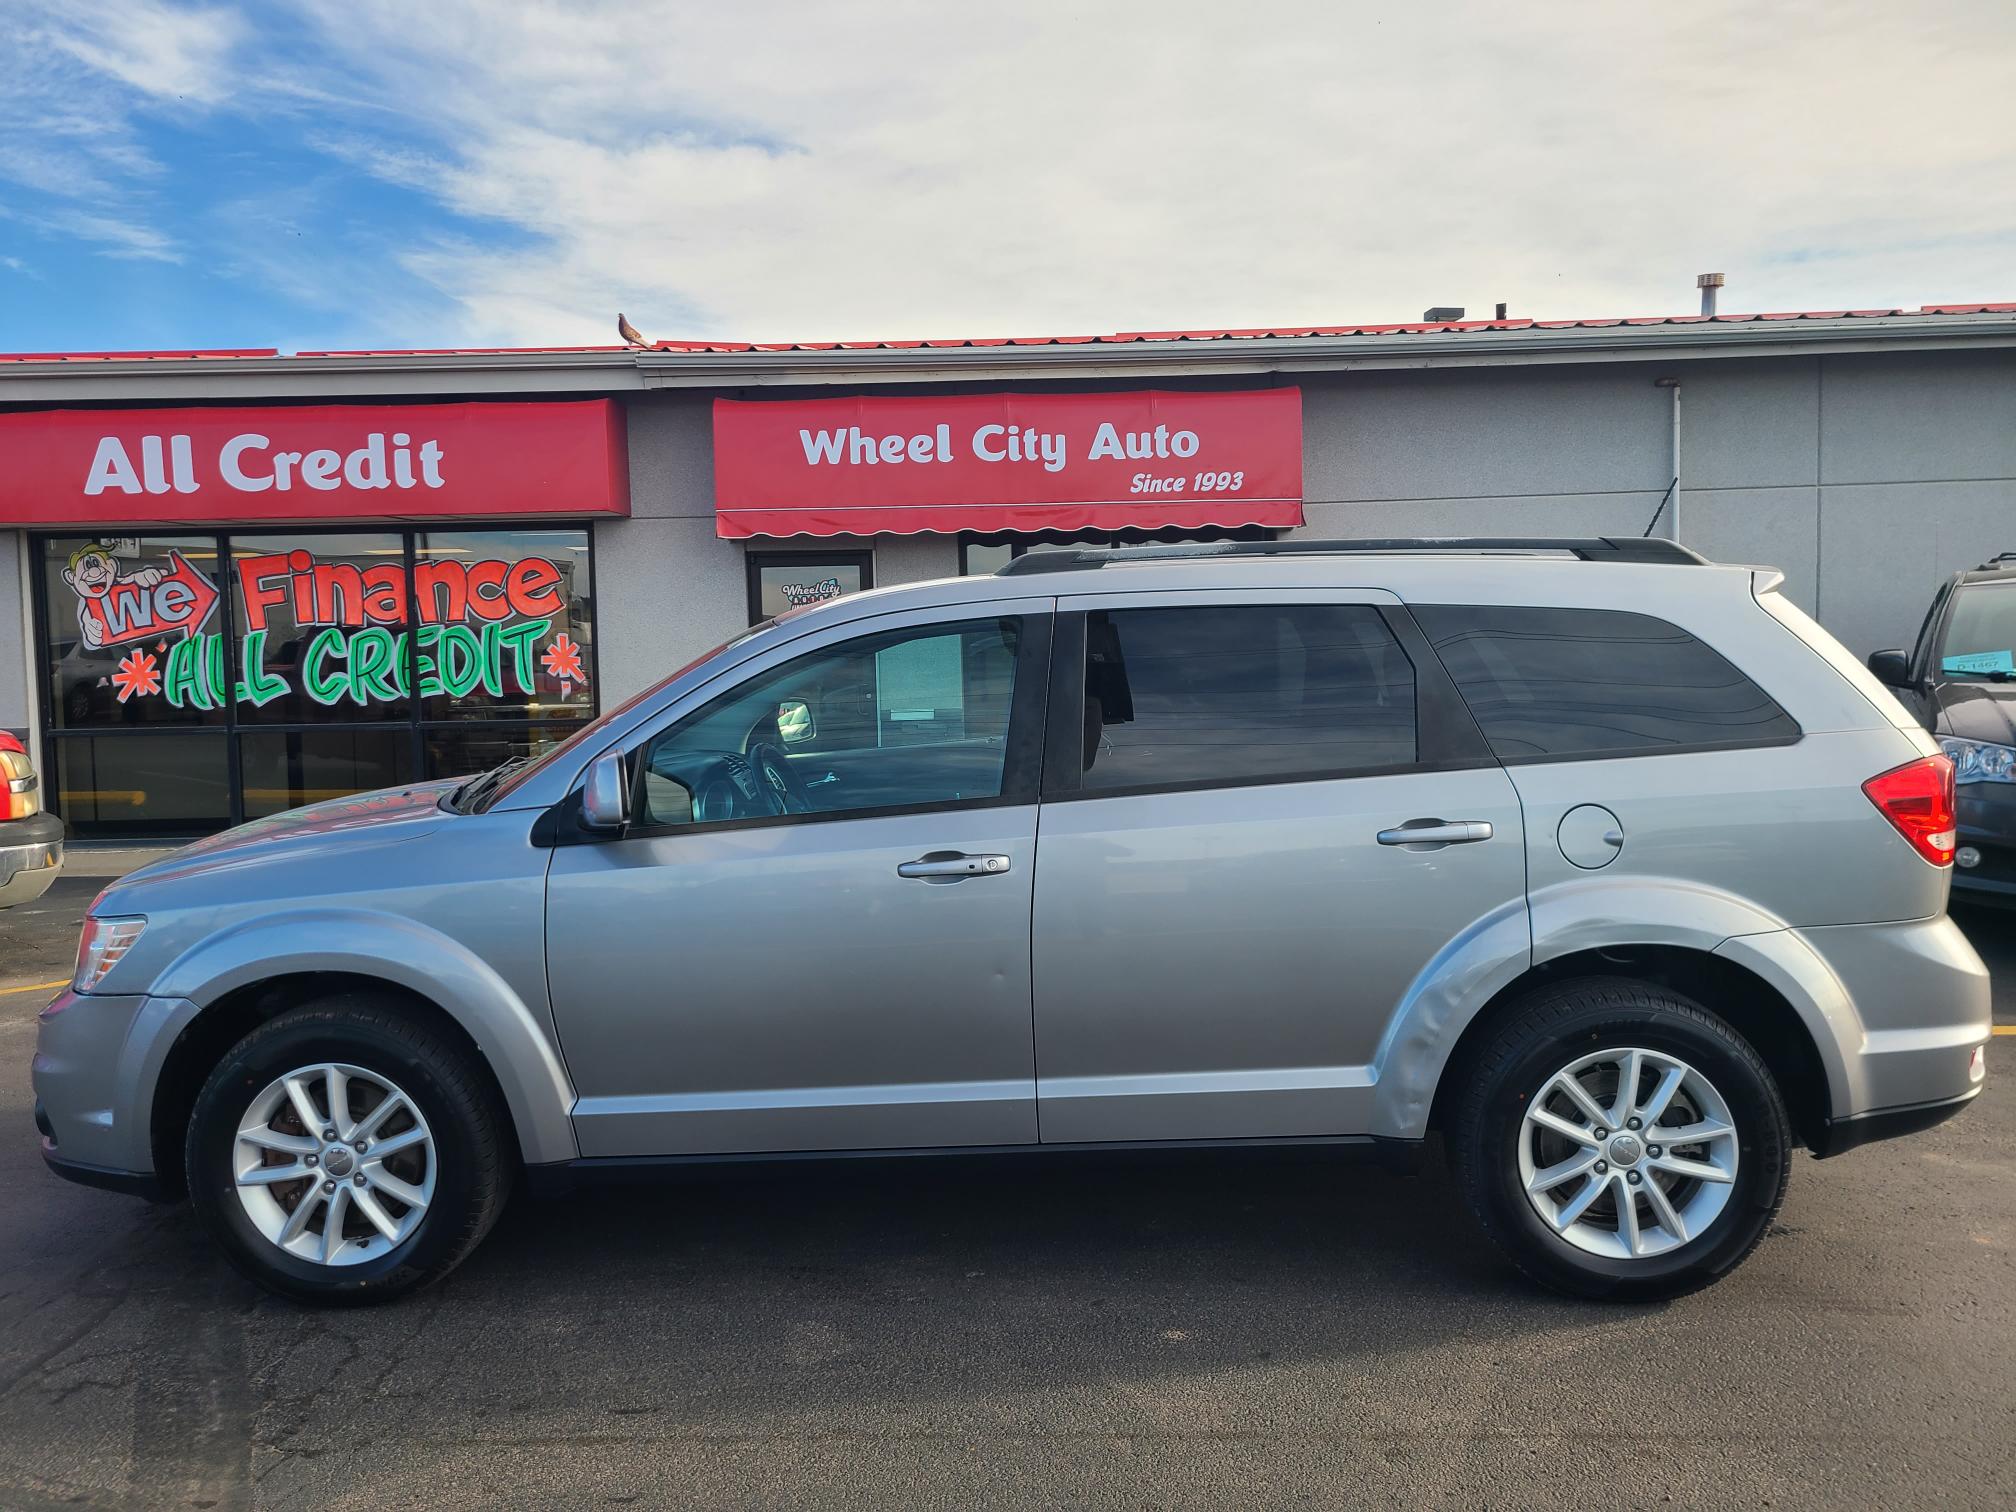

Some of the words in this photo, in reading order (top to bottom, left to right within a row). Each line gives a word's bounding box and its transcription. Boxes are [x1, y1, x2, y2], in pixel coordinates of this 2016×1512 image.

[83, 434, 201, 496] All
[218, 432, 446, 493] Credit
[799, 423, 954, 466] Wheel
[972, 423, 1067, 473] City
[1087, 422, 1200, 462] Auto
[1130, 472, 1187, 494] Since
[1193, 470, 1245, 493] 1993
[237, 548, 566, 630] Finance
[164, 631, 292, 710] ALL
[302, 619, 552, 707] CREDIT
